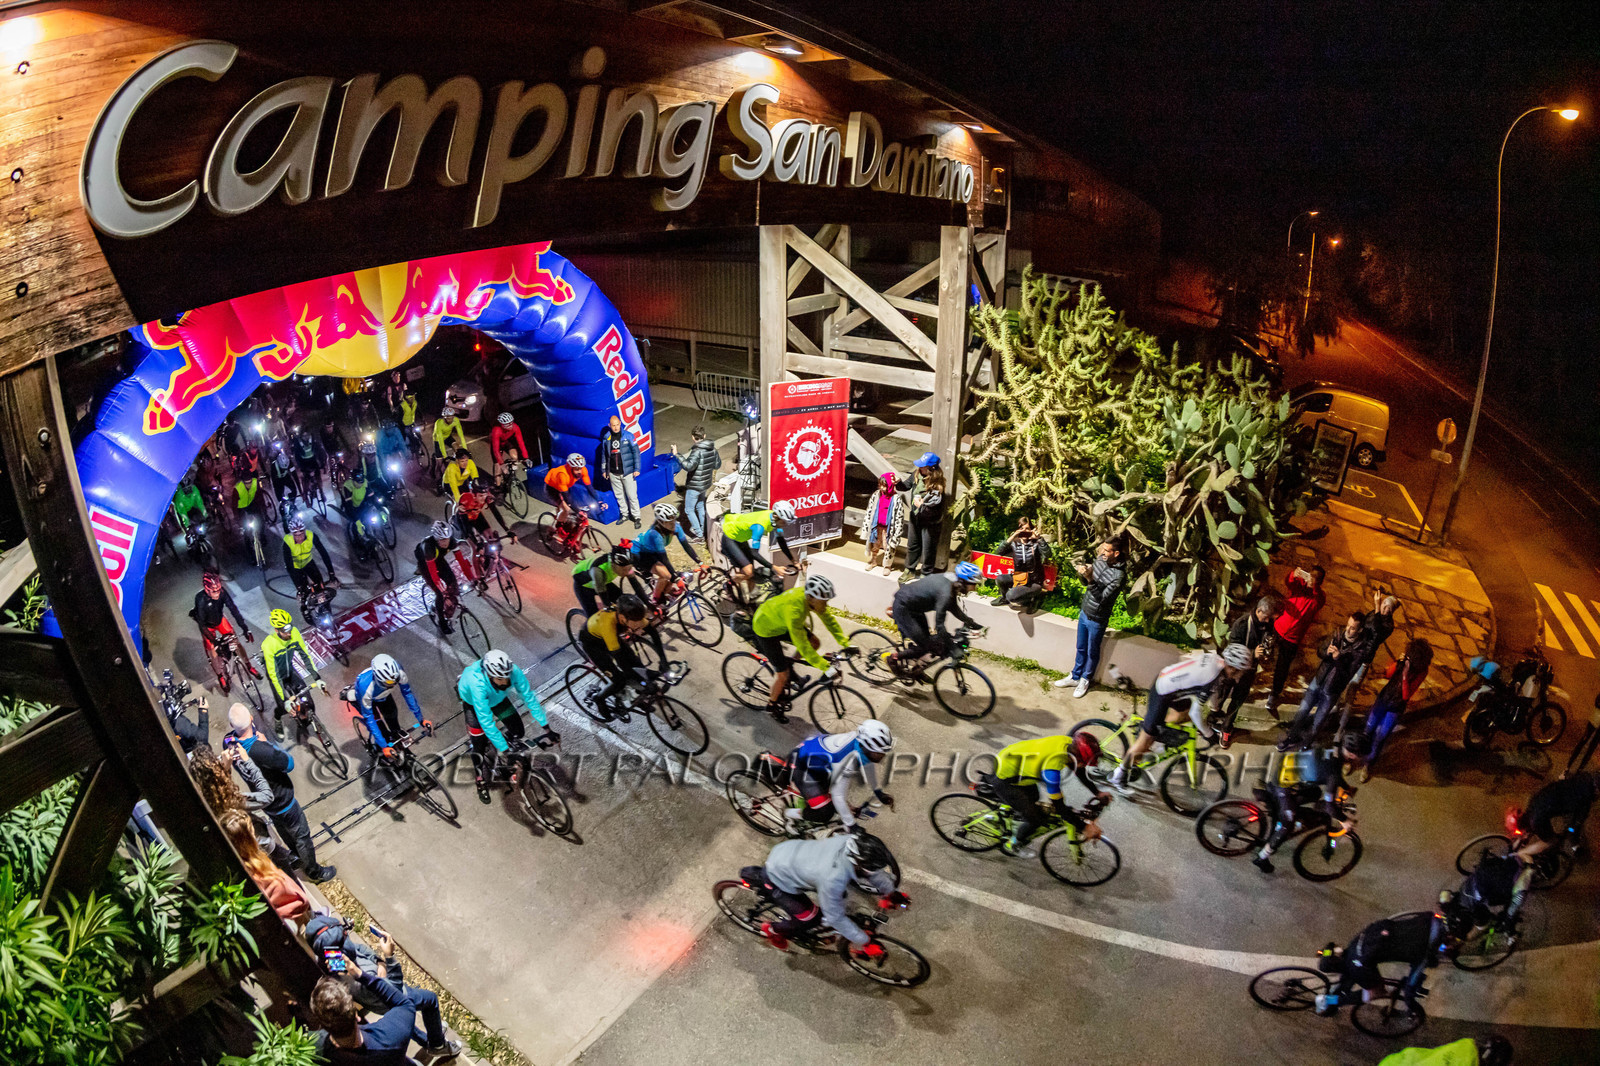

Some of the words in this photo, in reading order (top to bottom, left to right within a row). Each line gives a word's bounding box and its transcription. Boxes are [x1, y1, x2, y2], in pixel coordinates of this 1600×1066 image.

[82, 40, 717, 239] Camping
[725, 82, 841, 188] San
[846, 111, 975, 203] Damiano
[591, 324, 639, 401] Red
[617, 389, 652, 454] Bull
[88, 505, 139, 612] ull
[786, 491, 839, 510] ORSICA
